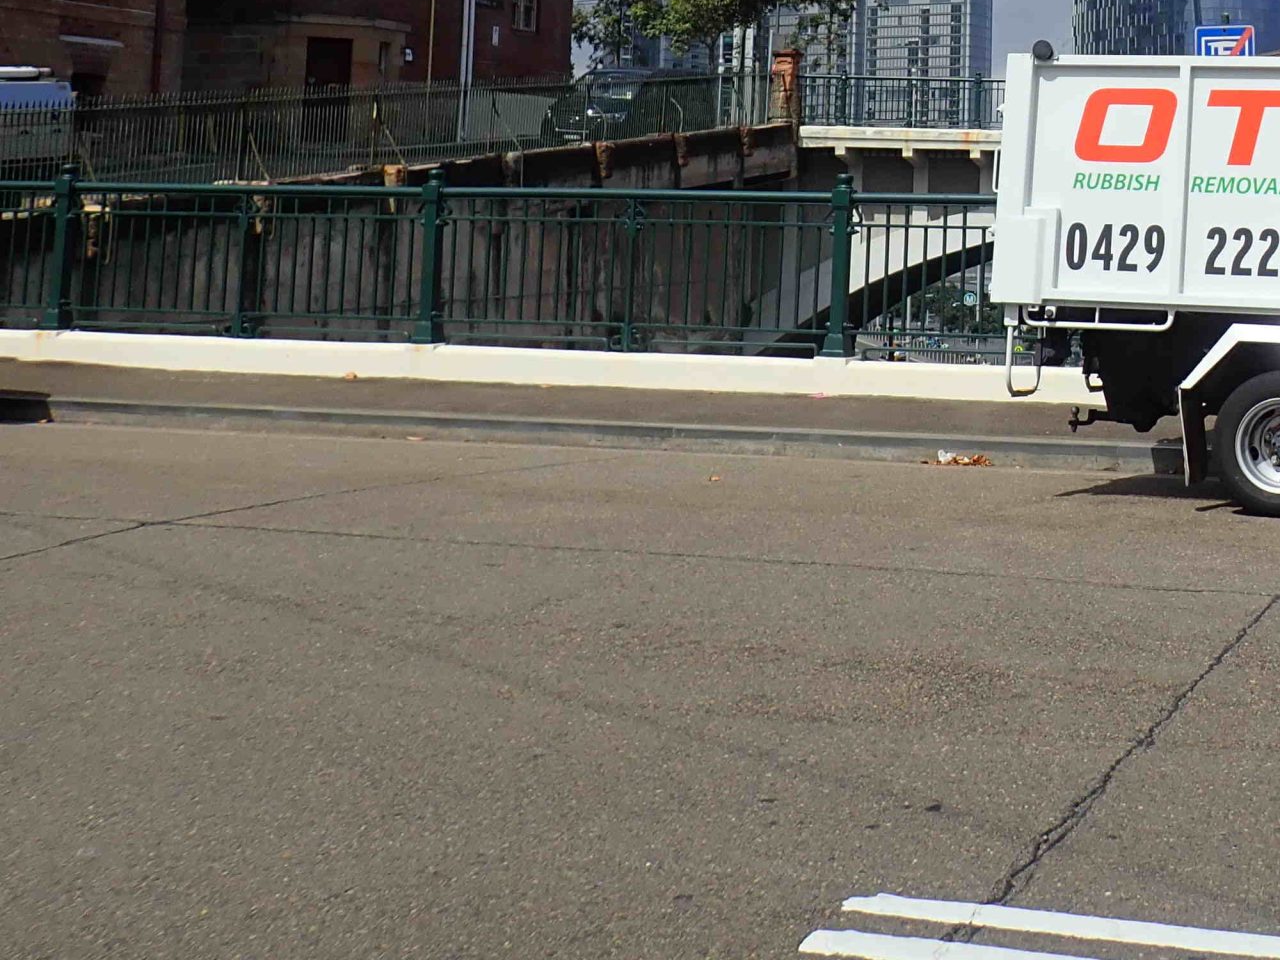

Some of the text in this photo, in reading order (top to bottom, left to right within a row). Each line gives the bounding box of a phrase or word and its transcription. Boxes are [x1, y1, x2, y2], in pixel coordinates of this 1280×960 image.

[1073, 172, 1161, 192] RUBBISH
[1065, 222, 1166, 273] 0429
[1204, 226, 1280, 278] 222
